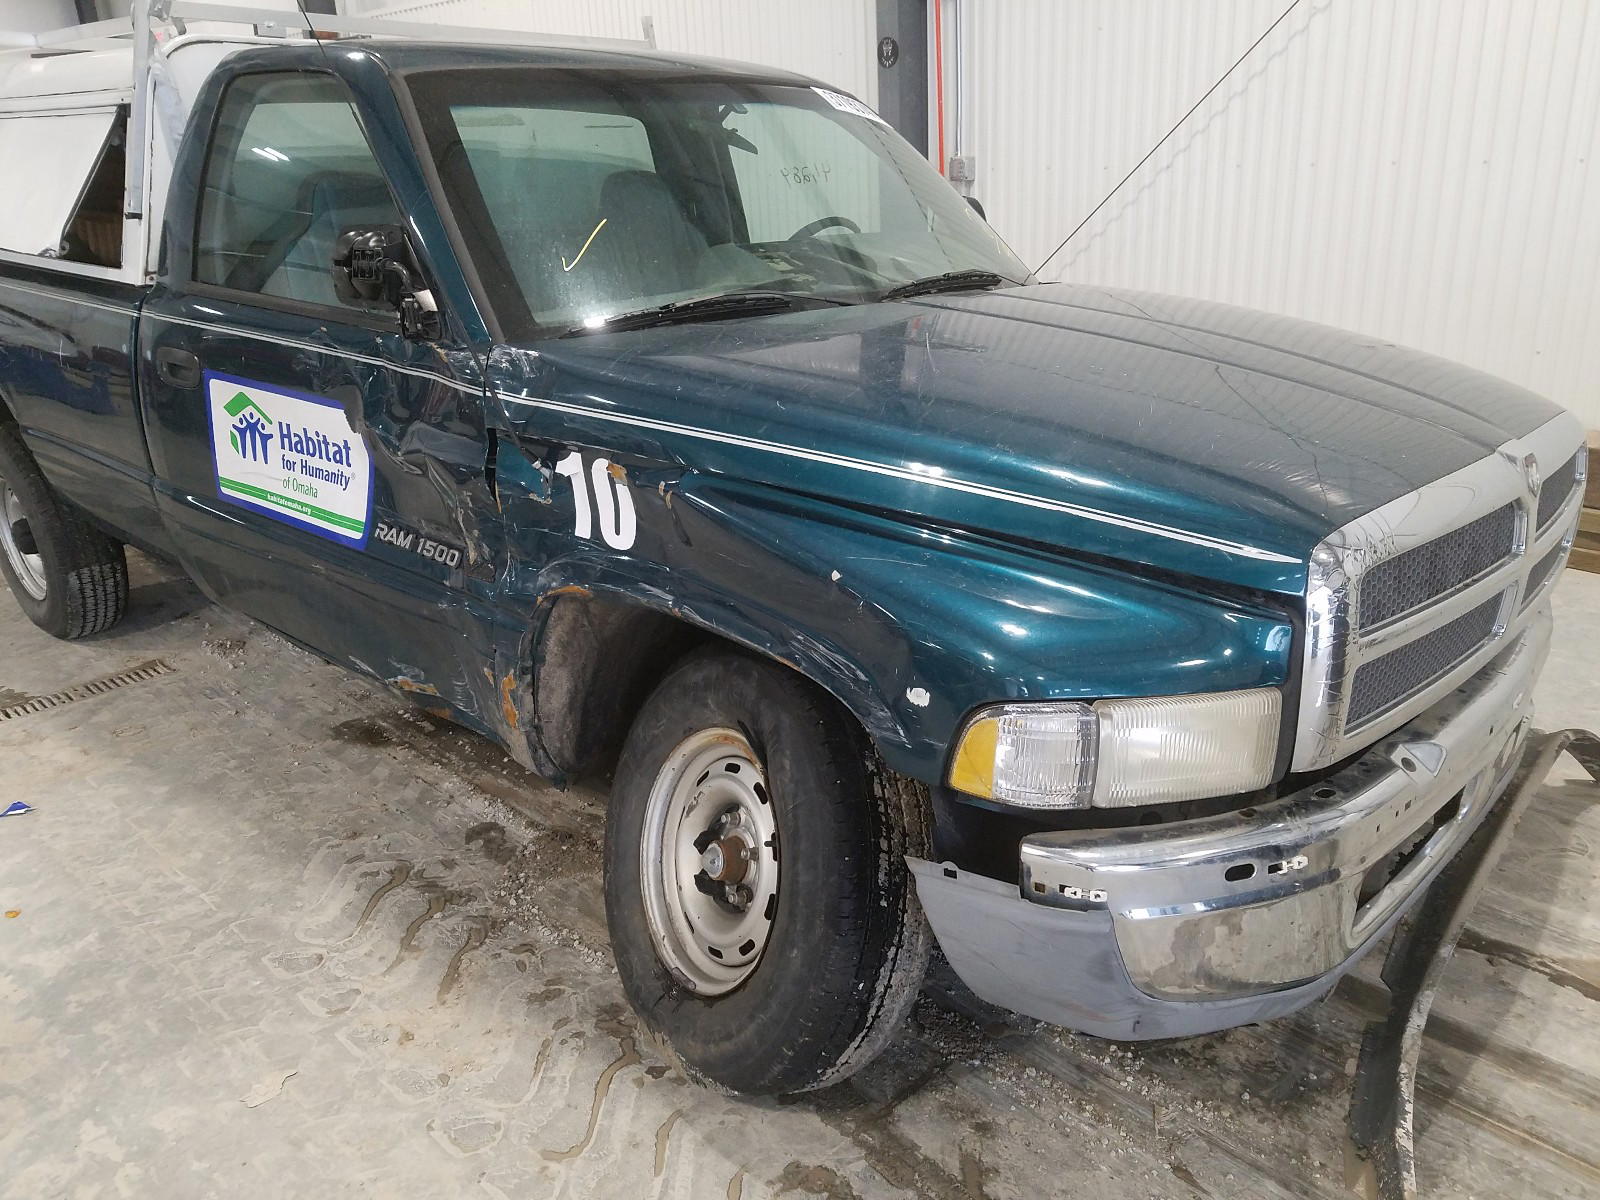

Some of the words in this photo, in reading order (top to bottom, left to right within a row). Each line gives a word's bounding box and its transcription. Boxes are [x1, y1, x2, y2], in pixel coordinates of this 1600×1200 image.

[278, 421, 352, 468] Habitat
[281, 454, 297, 472] for
[300, 458, 351, 491] Humanity
[282, 477, 291, 489] of
[292, 478, 318, 498] Omaha
[555, 451, 637, 551] 10
[374, 523, 413, 550] RAM
[416, 538, 459, 567] 1500
